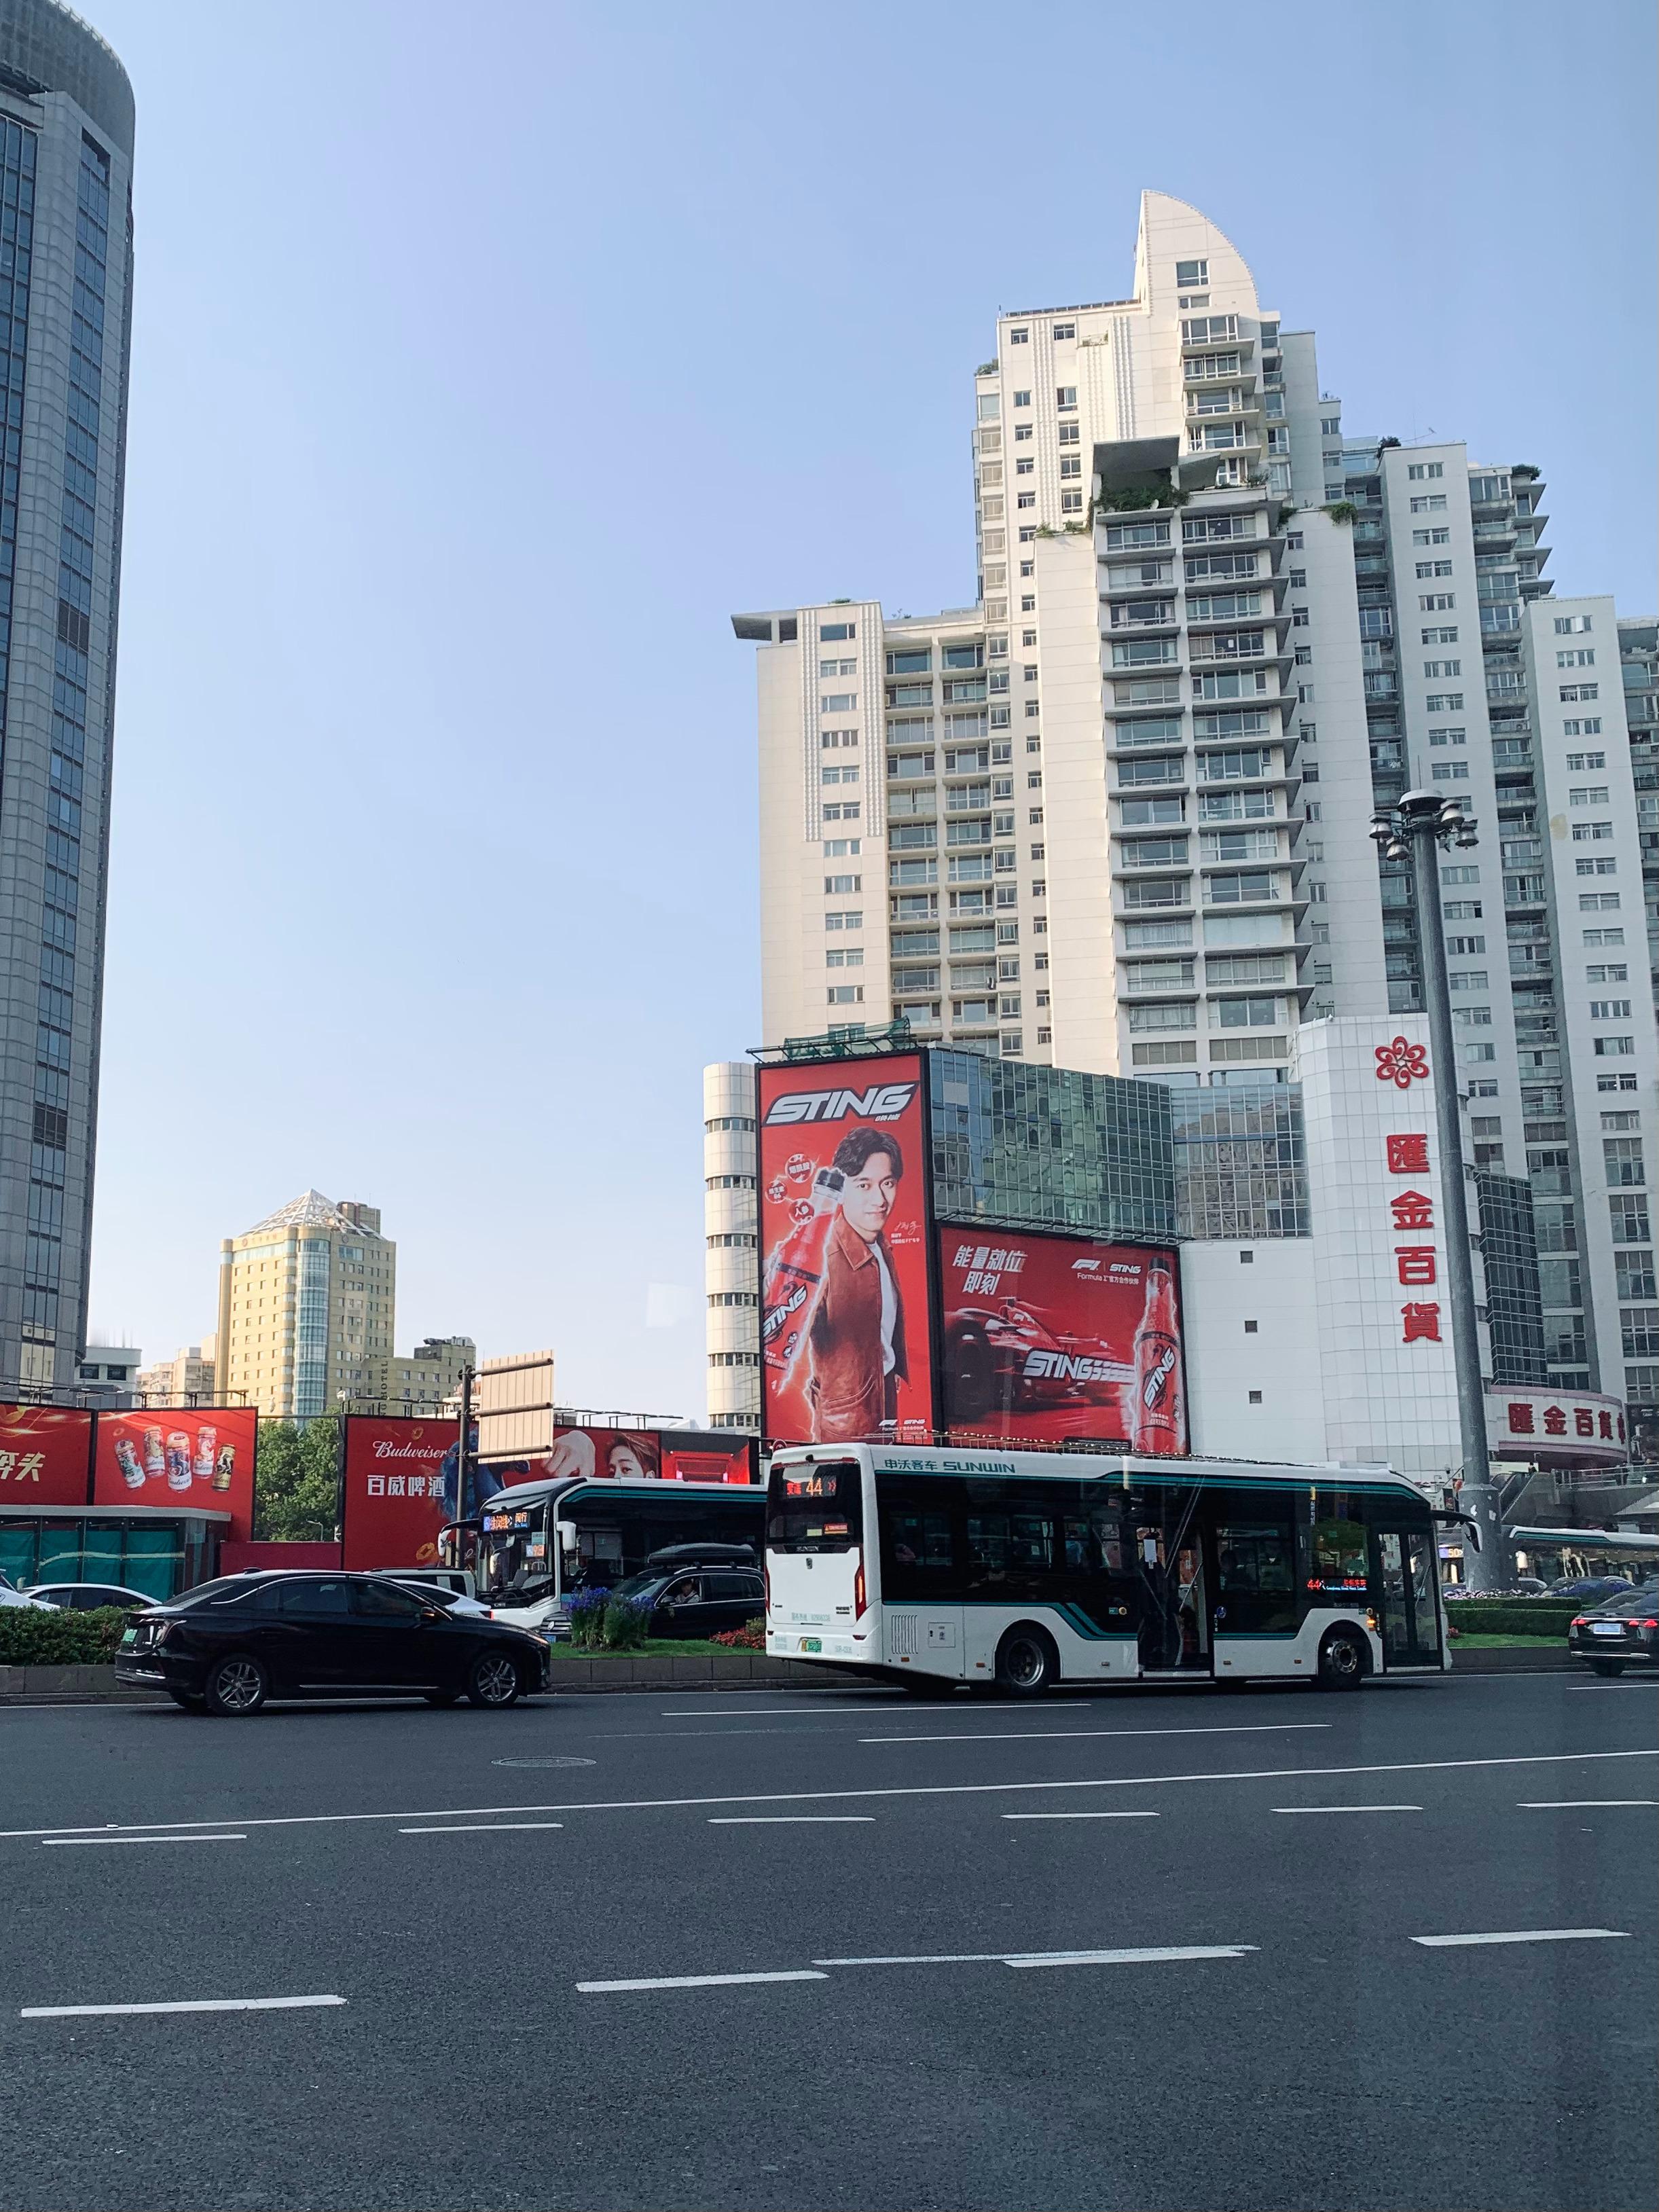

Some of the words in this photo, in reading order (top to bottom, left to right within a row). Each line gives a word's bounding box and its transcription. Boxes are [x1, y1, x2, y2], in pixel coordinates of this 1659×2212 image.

[766, 1084, 915, 1125] STING
[1386, 1133, 1443, 1343] 匯金百貨
[952, 1244, 1028, 1273] 能量就位
[1109, 1263, 1142, 1274] STING
[962, 1270, 1001, 1296] 即刻
[1077, 1272, 1102, 1282] Formula
[1022, 1350, 1094, 1381] STING
[1144, 1347, 1175, 1409] STING
[372, 1440, 448, 1458] Budweiser
[884, 1458, 938, 1471] 申沃客车
[943, 1461, 1016, 1474] SUNWIN
[367, 1474, 446, 1498] 百威啤酒
[805, 1477, 823, 1496] 44
